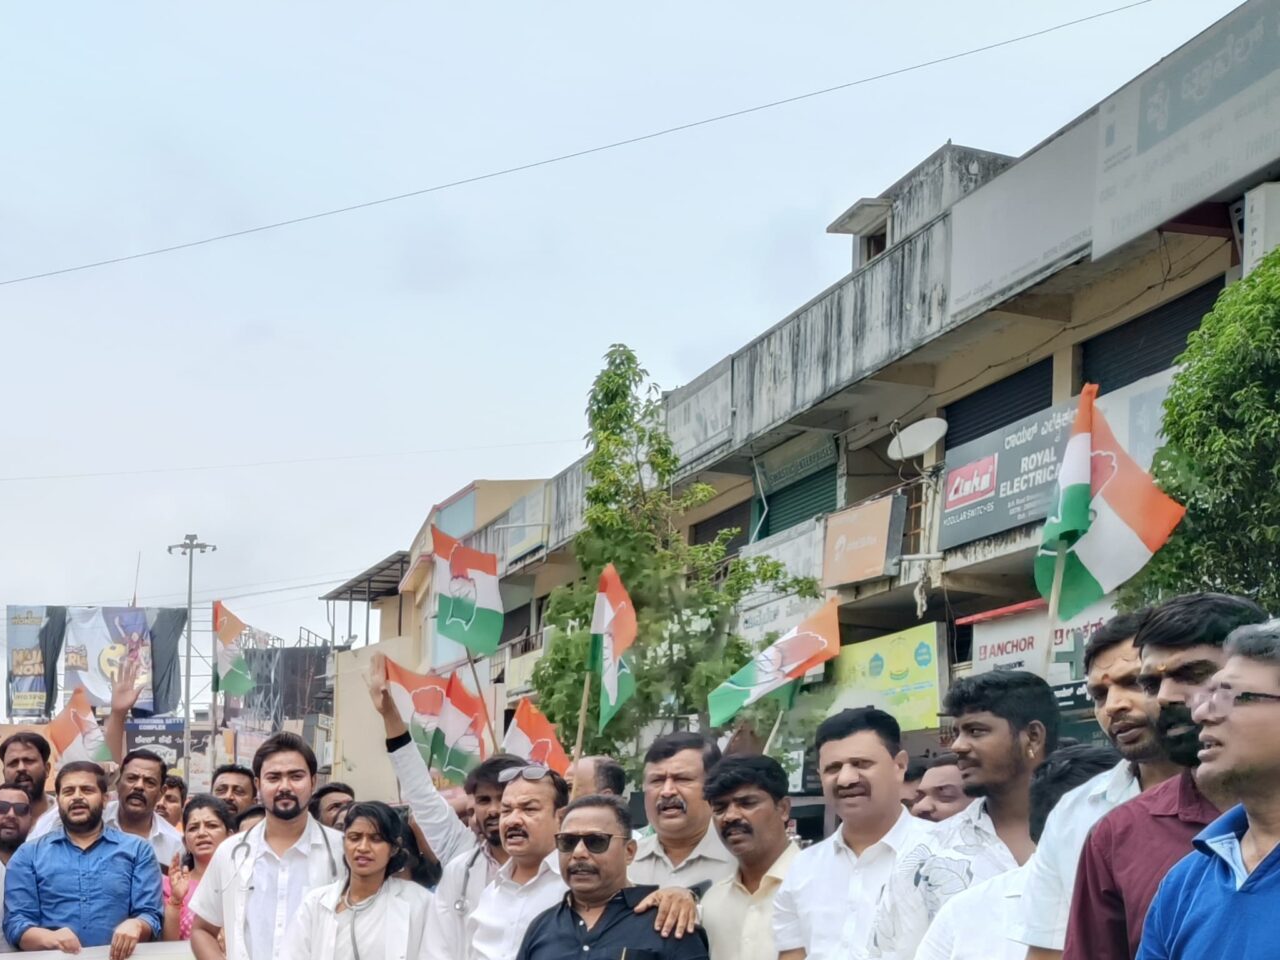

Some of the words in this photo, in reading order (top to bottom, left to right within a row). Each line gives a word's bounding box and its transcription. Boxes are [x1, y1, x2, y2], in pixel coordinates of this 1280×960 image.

[1021, 446, 1057, 473] ROYAL
[999, 462, 1063, 498] ELECTRICA
[988, 635, 1035, 658] ANCHOR
